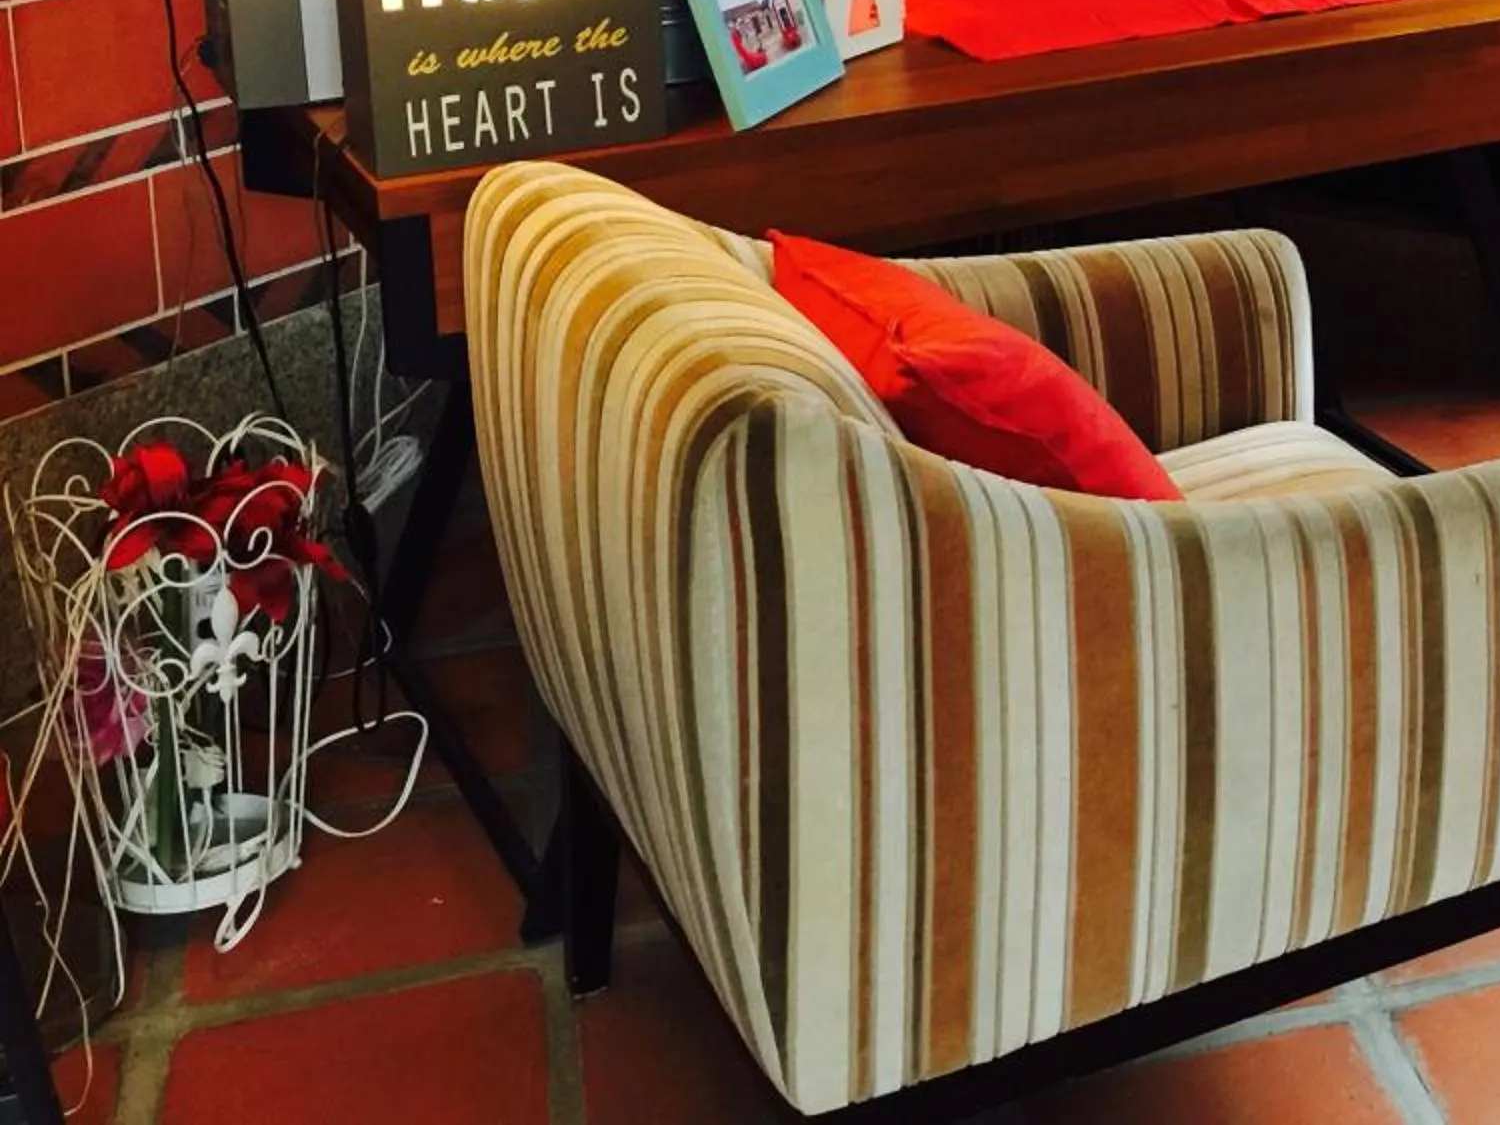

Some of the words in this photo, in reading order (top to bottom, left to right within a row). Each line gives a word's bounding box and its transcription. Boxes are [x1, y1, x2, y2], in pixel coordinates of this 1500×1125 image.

[407, 50, 441, 76] is
[456, 32, 561, 69] where
[575, 18, 630, 53] the
[406, 80, 557, 157] HEART
[591, 67, 641, 128] IS
